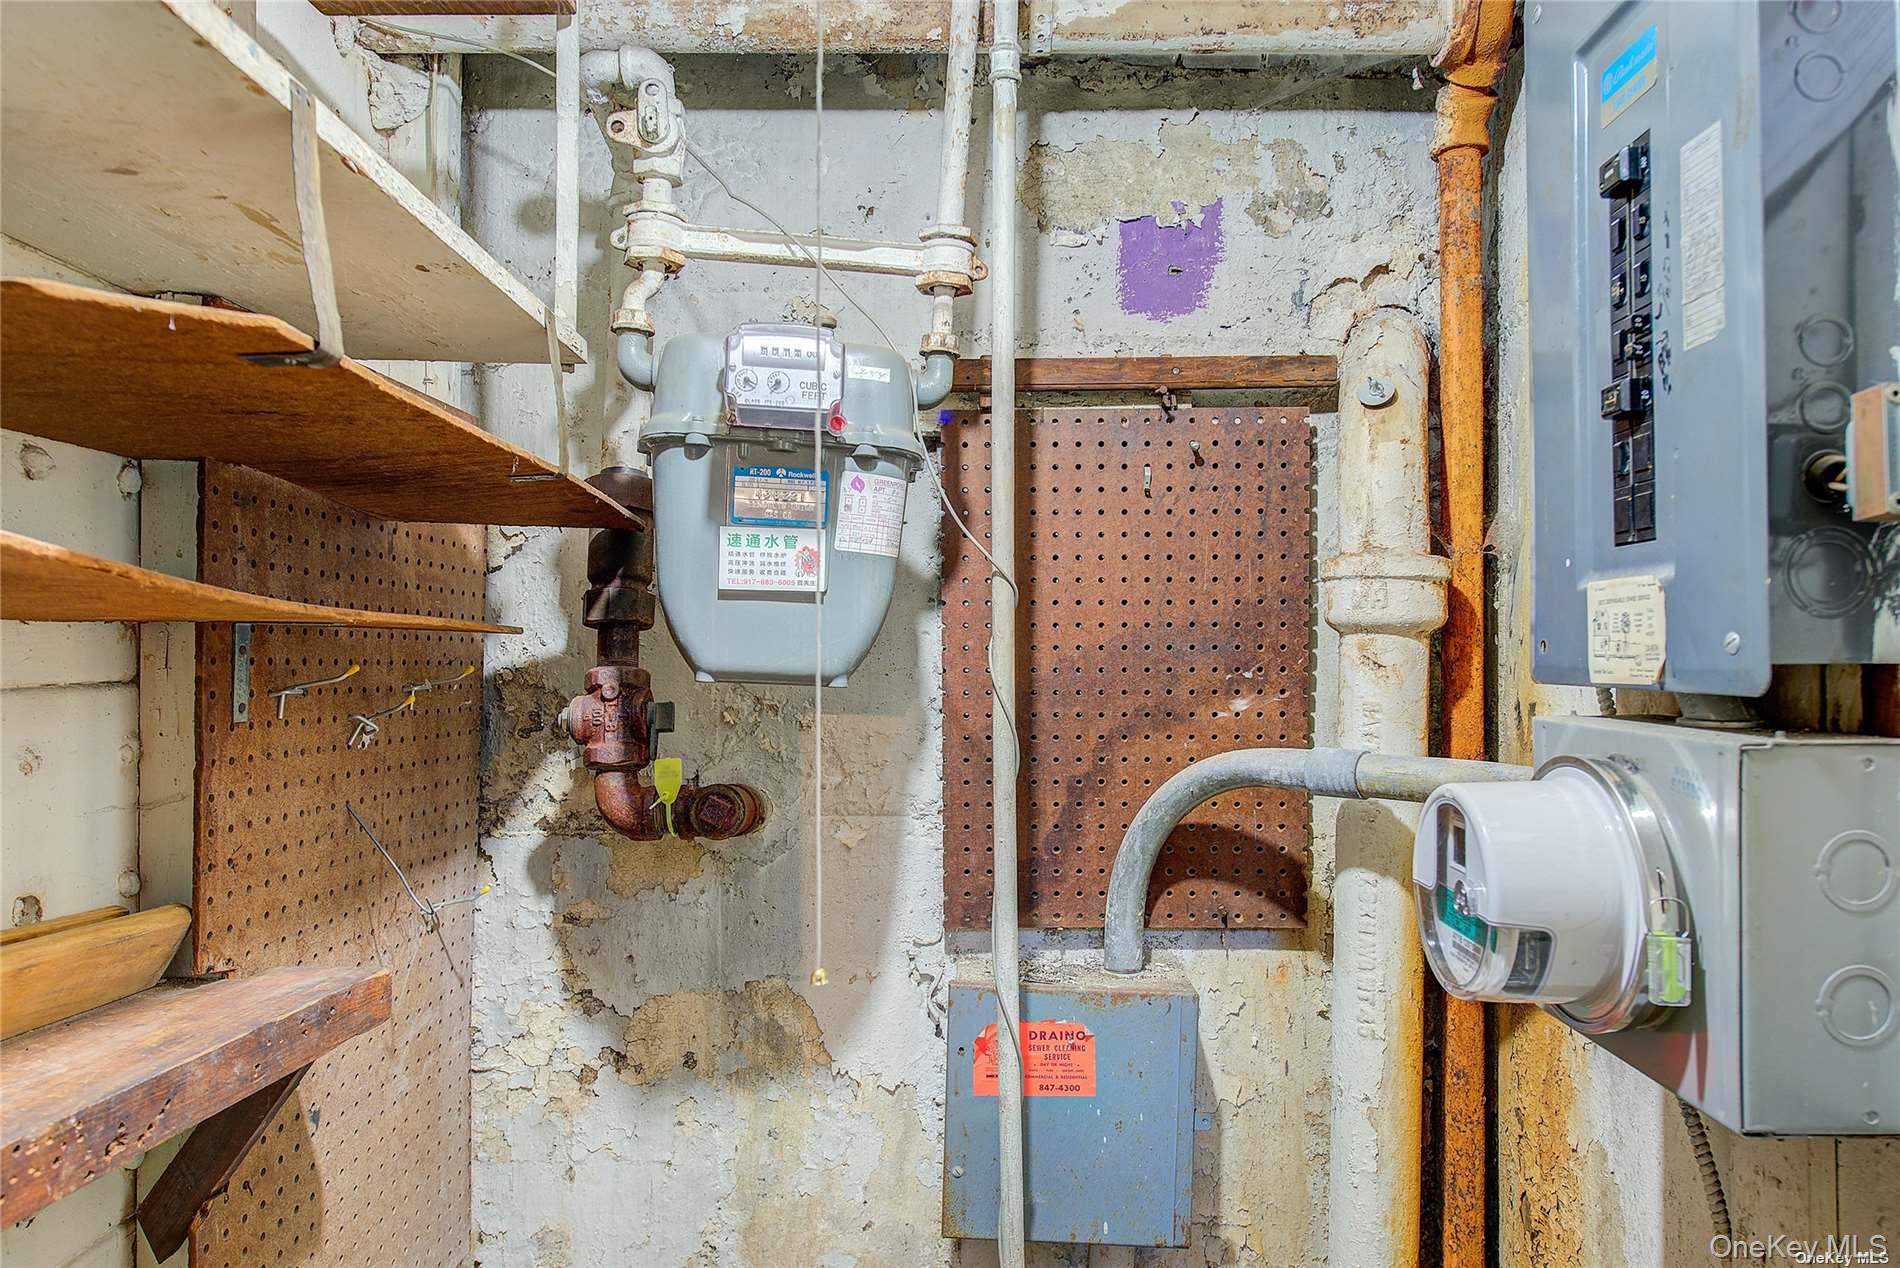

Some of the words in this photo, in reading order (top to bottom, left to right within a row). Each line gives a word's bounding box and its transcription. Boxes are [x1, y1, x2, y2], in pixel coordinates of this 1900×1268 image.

[727, 533, 798, 549] 速通水管
[1028, 1044, 1050, 1052] SEWER
[1039, 1084, 1081, 1092] 847-4300
